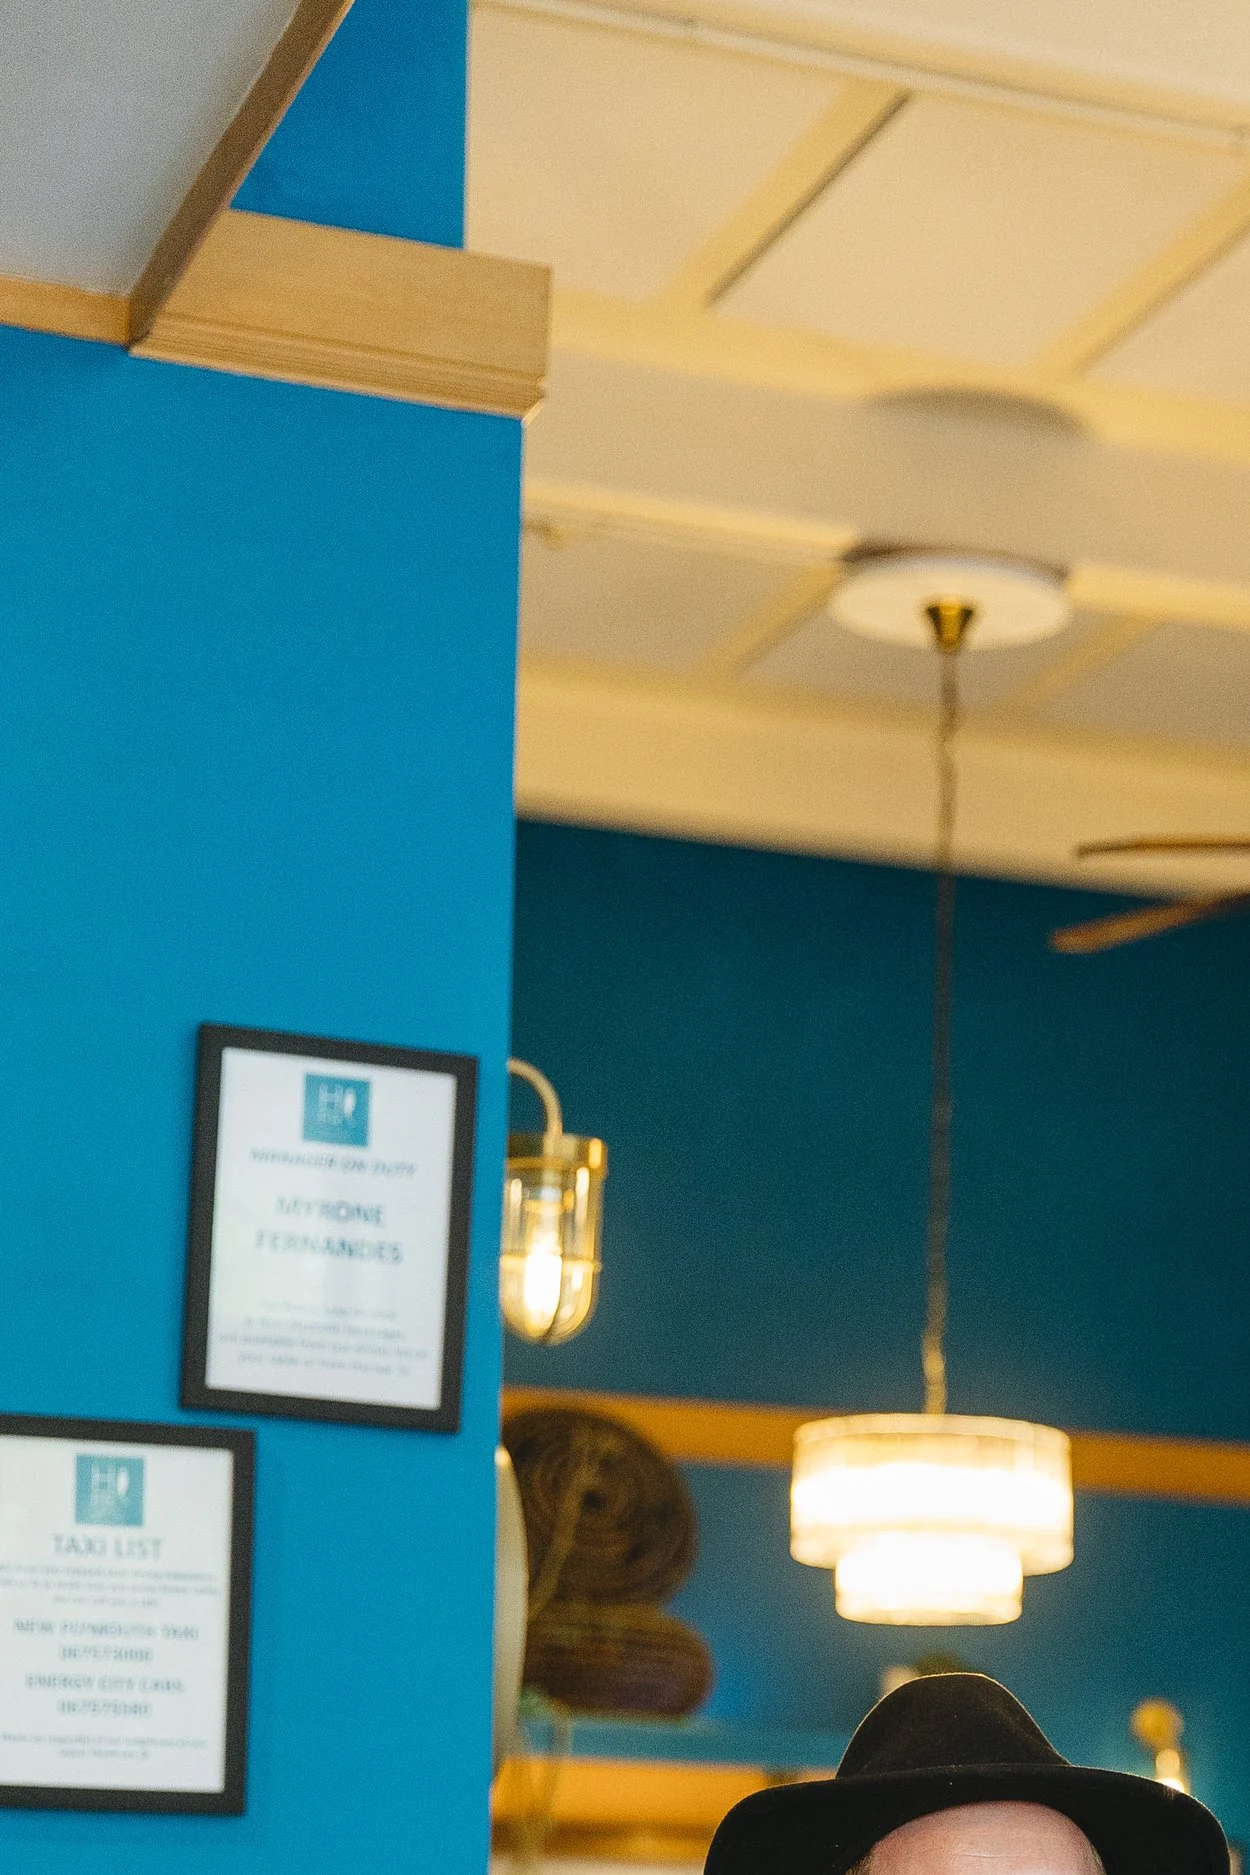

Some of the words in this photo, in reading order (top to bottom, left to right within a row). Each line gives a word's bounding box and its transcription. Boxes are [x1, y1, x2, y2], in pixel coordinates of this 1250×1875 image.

[255, 1230, 404, 1265] FERNANDES
[52, 1534, 107, 1558] TAXI
[113, 1537, 162, 1561] LIST
